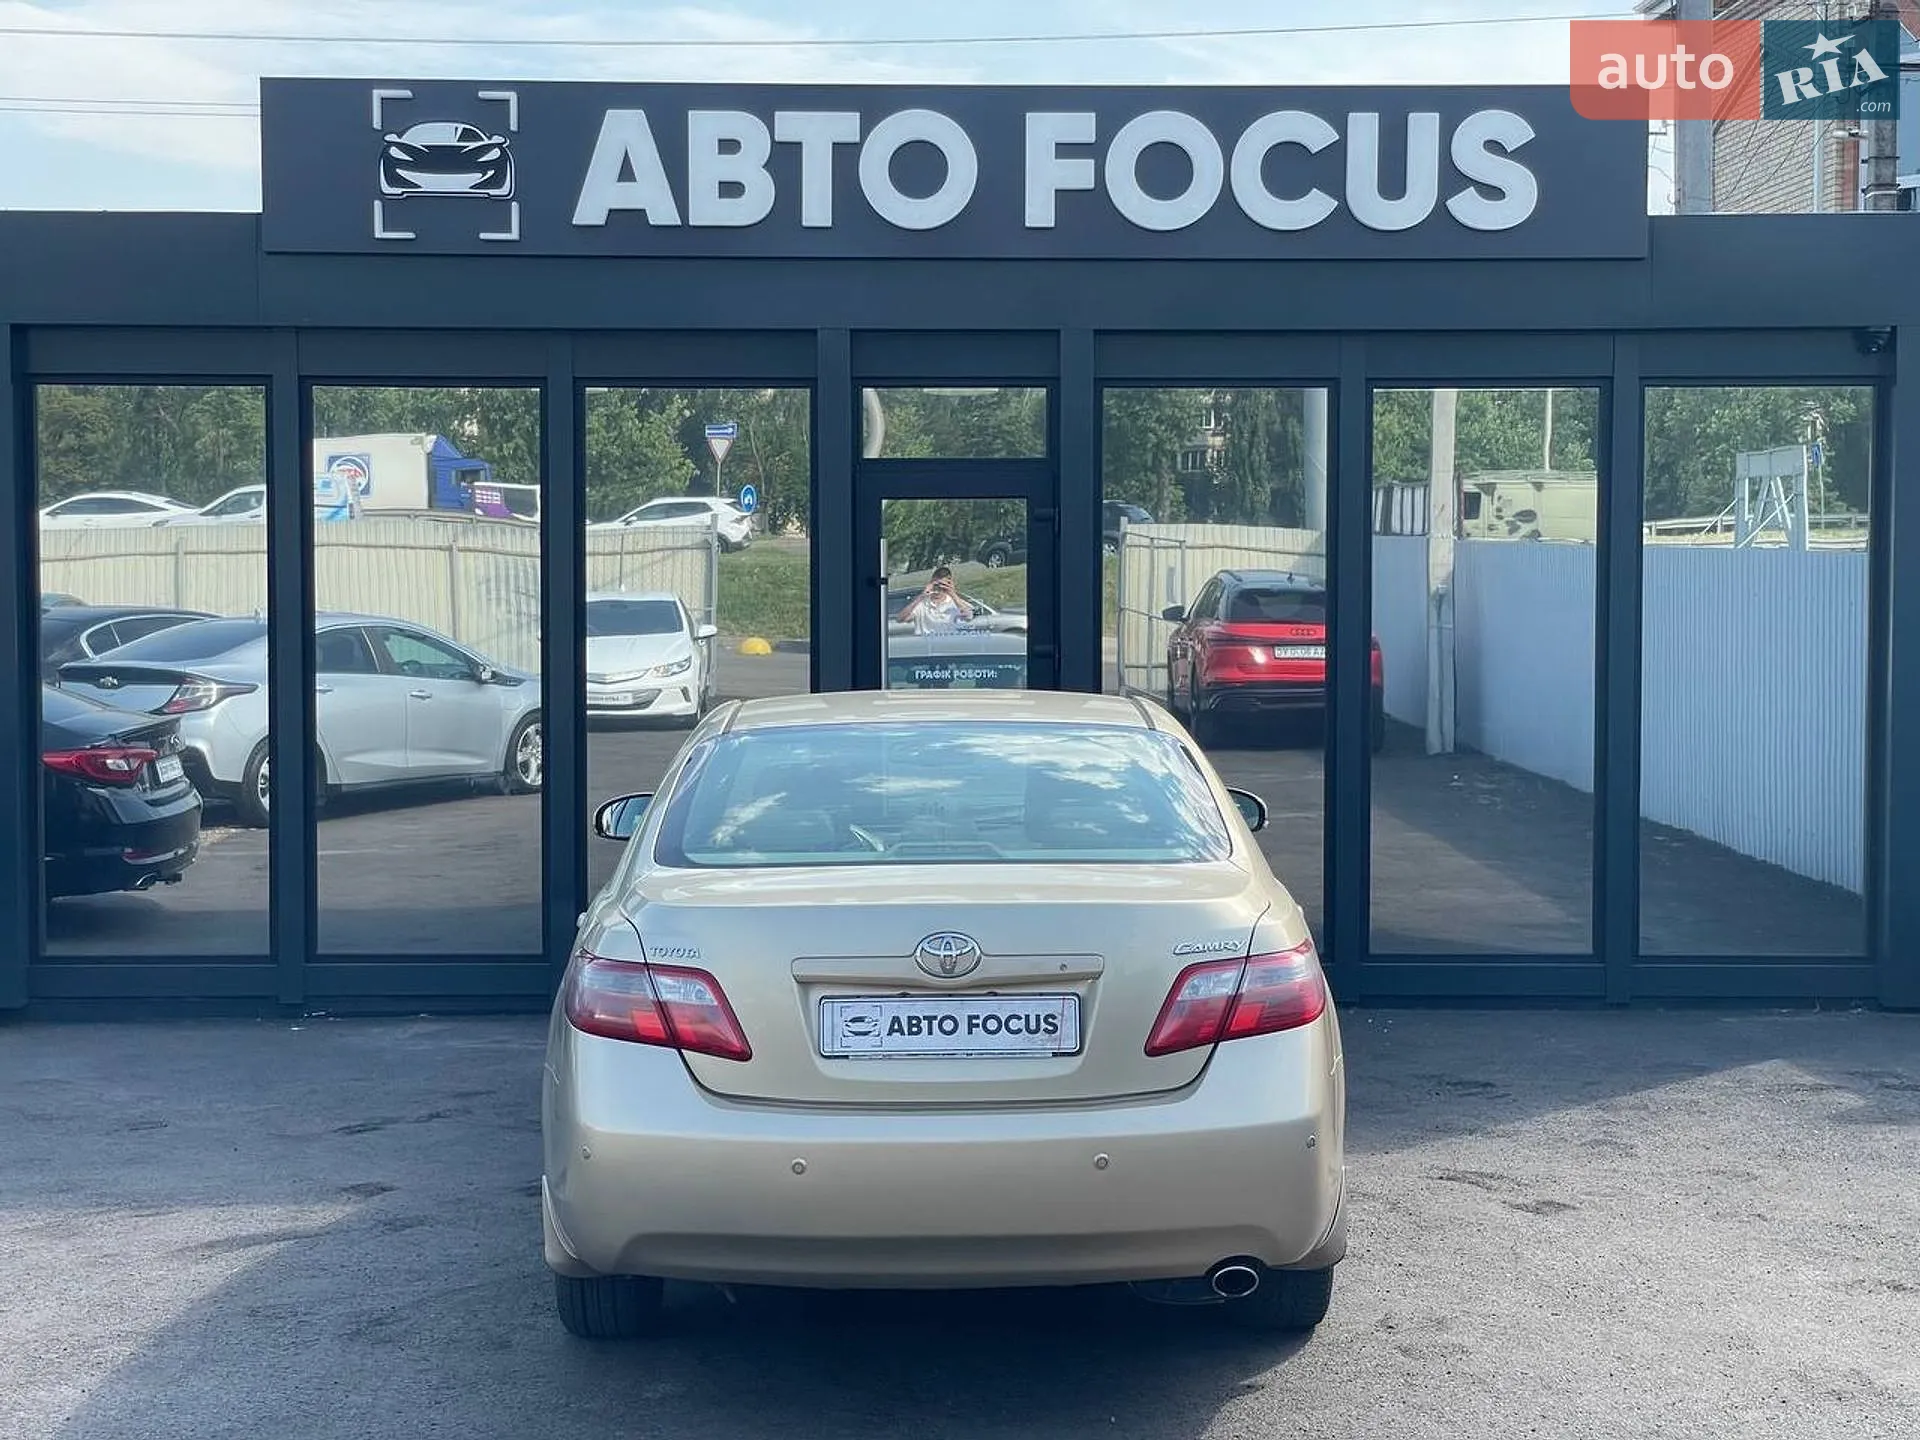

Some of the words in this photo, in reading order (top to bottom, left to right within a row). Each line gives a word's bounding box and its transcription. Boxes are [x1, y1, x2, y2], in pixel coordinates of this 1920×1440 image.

[572, 108, 978, 231] АВТО
[1024, 109, 1539, 232] FOCUS
[649, 946, 702, 959] TOYOTA
[886, 1014, 960, 1037] АВТО
[966, 1013, 1060, 1036] FOCUS
